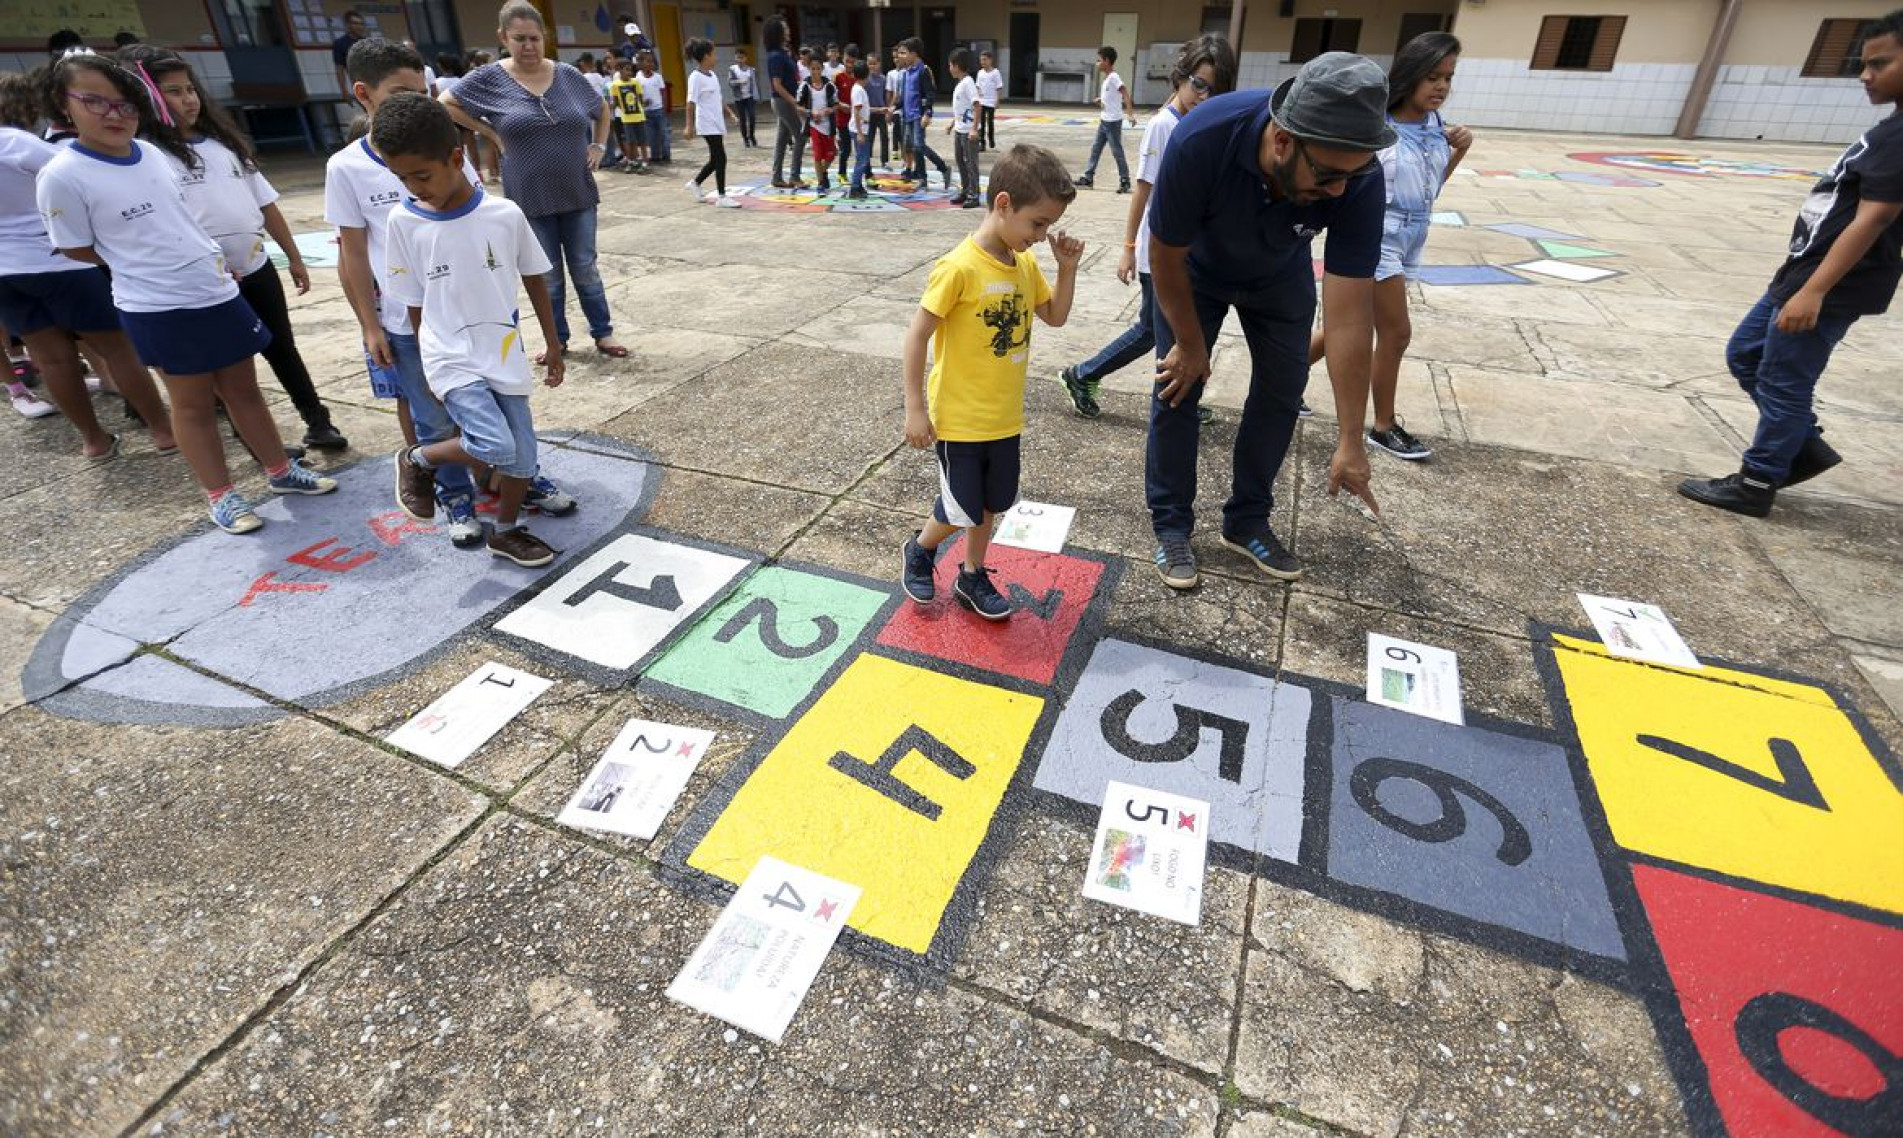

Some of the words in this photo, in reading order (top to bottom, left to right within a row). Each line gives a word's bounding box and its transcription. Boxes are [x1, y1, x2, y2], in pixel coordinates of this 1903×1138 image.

[1017, 505, 1044, 517] 3
[561, 560, 684, 612] 1
[711, 597, 839, 660] 2
[1600, 605, 1638, 621] 7
[1385, 646, 1423, 665] 6
[479, 672, 515, 689] 1
[628, 733, 673, 755] 2
[1099, 687, 1251, 786] 5
[826, 722, 978, 822] 4
[1635, 732, 1833, 813] 7
[1125, 798, 1169, 826] 5
[1350, 756, 1533, 868] 6
[761, 880, 807, 914] 4
